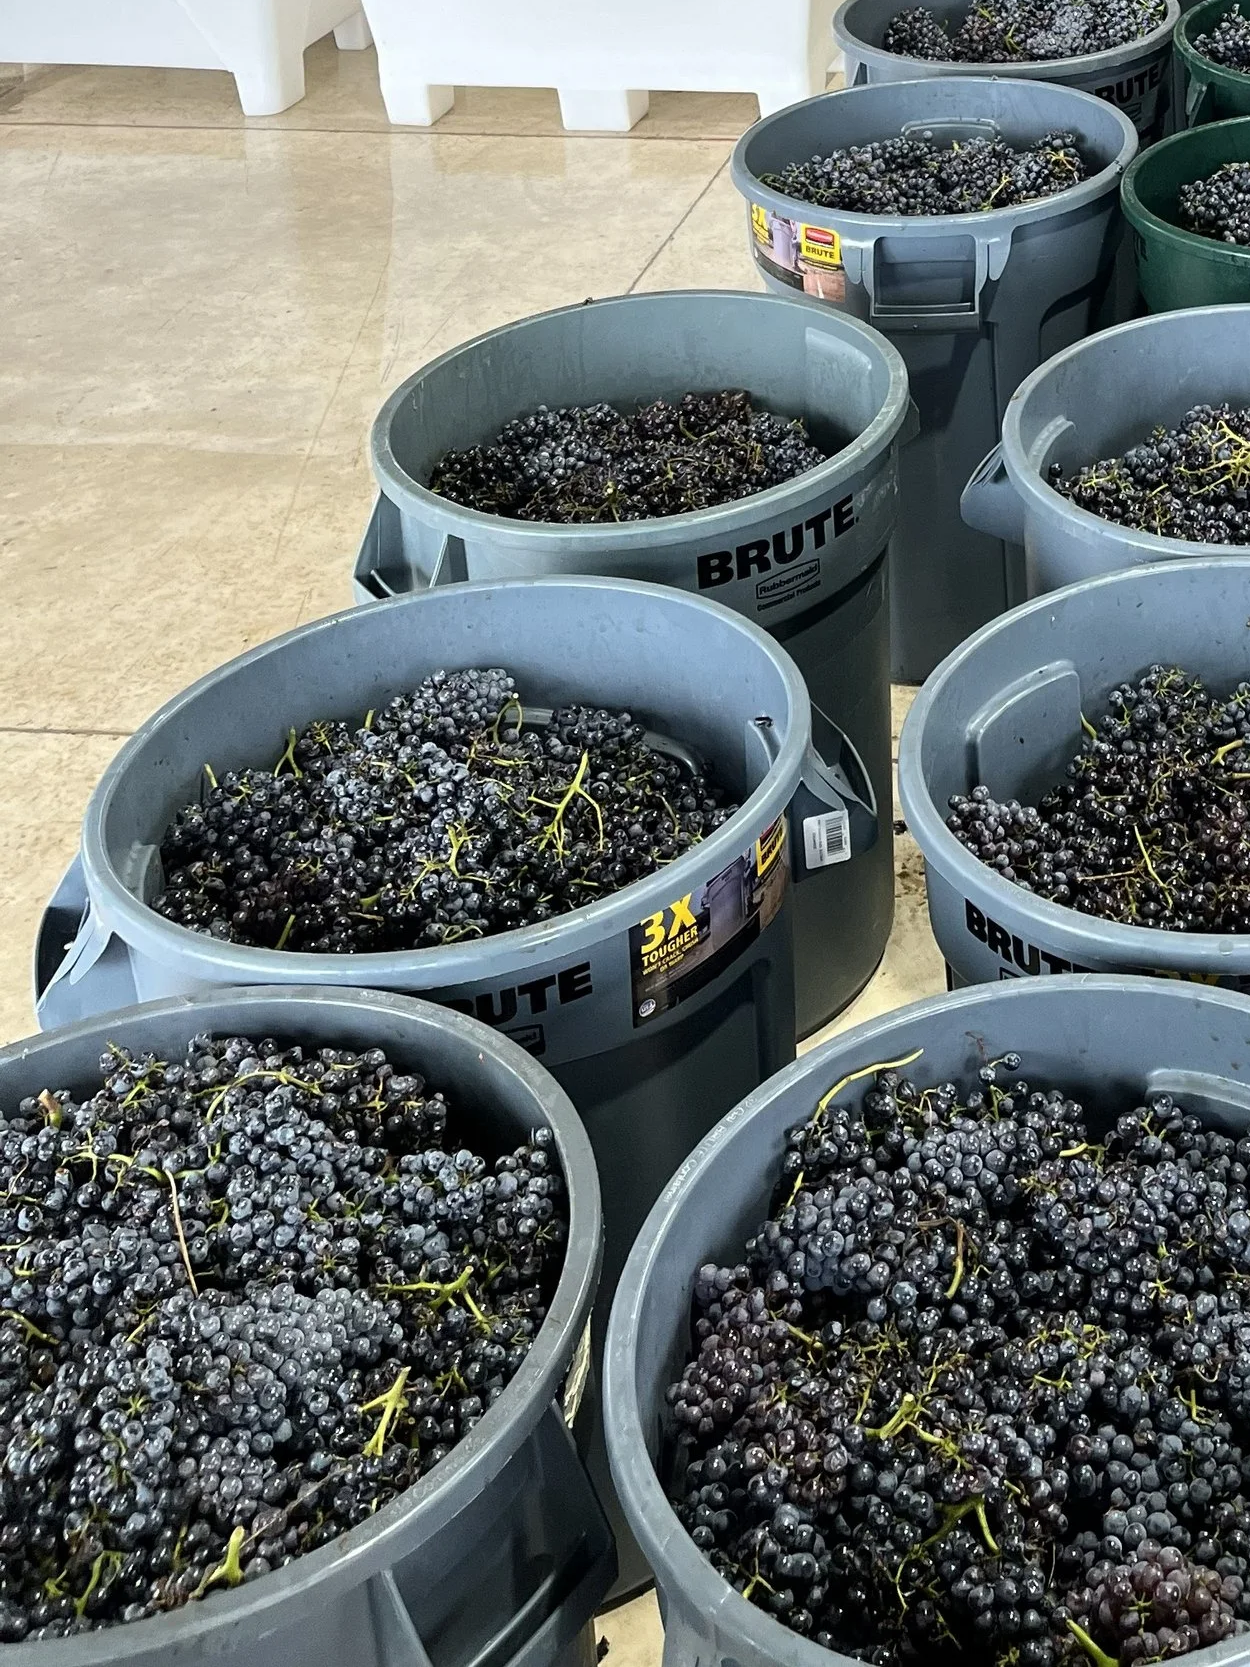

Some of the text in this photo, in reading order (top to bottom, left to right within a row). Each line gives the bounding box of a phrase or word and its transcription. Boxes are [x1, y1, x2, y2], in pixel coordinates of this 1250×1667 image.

[1092, 61, 1160, 106] RUTE
[805, 245, 835, 259] BRUTE
[697, 493, 856, 590] BRUTE
[757, 580, 821, 612] Commercial Products
[758, 563, 818, 596] Rubbermaid
[639, 892, 697, 955] 3X
[641, 925, 698, 967] TOUGHER
